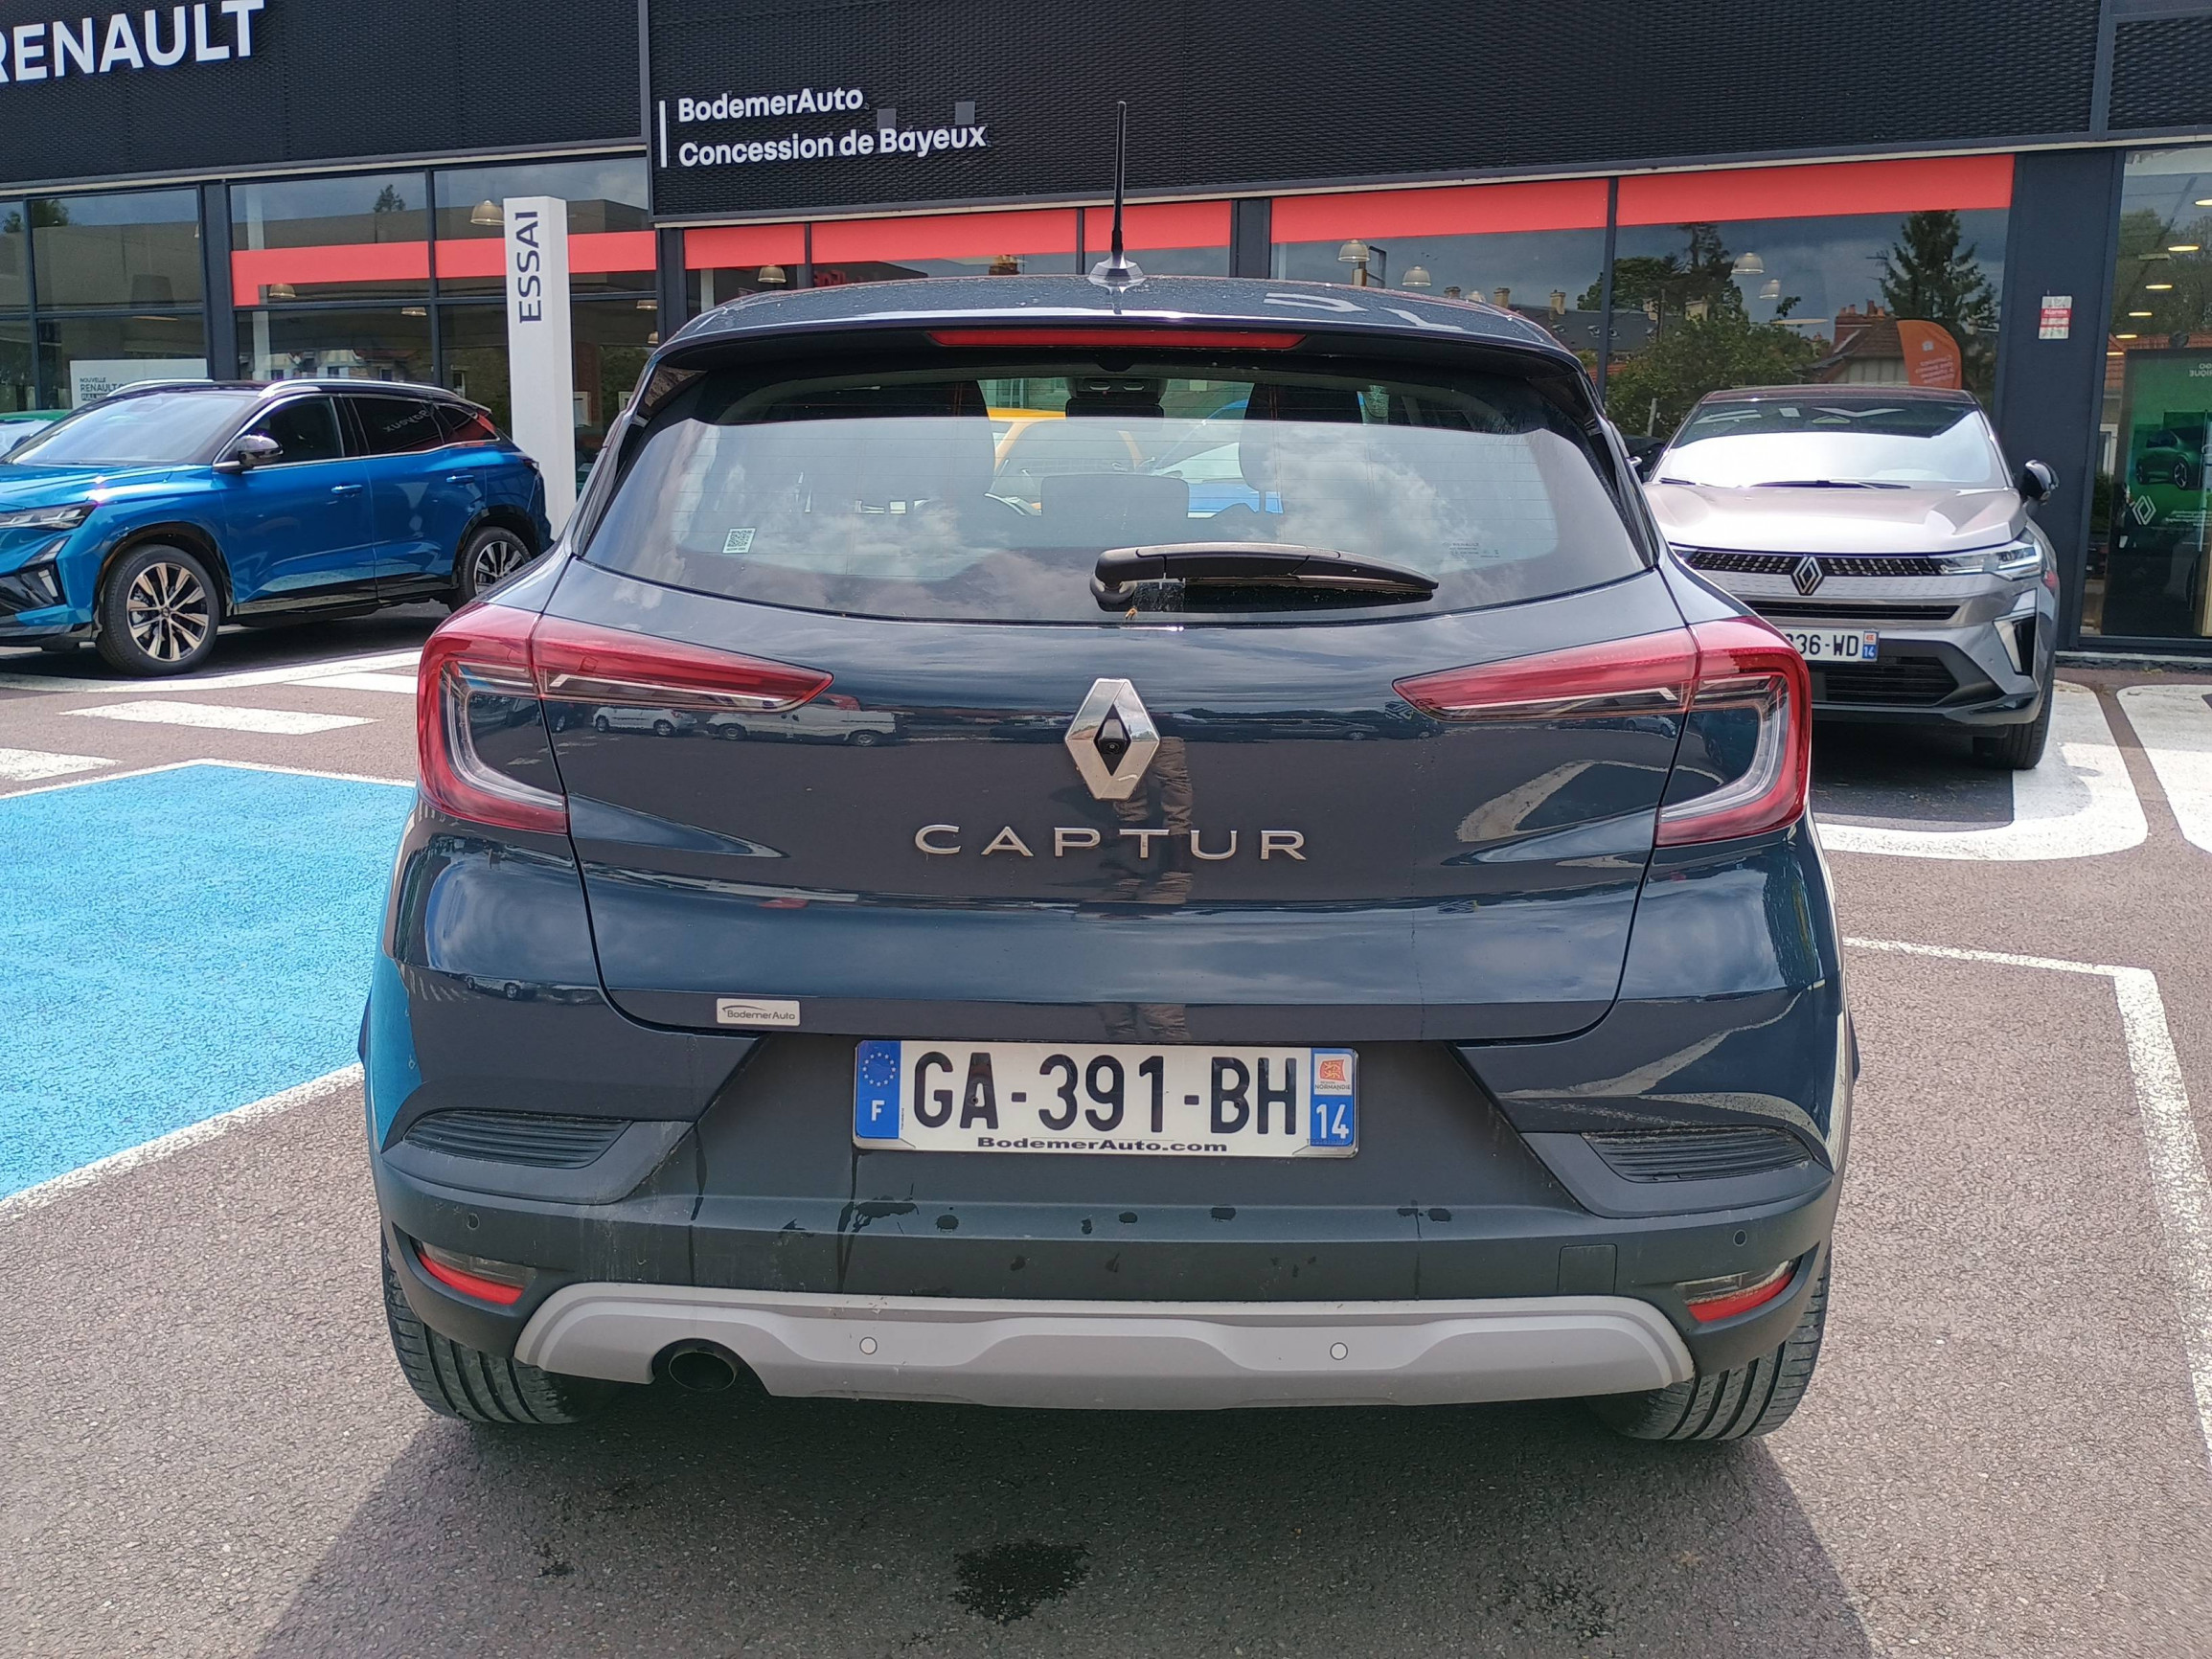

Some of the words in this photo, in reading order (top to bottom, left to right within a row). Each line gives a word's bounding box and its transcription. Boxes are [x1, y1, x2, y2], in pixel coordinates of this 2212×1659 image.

[0, 0, 265, 83] ENAULT
[677, 86, 864, 123] BodemerAuto
[678, 133, 835, 168] Concession
[839, 129, 875, 156] de
[878, 125, 989, 158] Bayeux
[514, 211, 542, 324] ESSAI
[80, 383, 117, 392] RENAULT
[915, 824, 1307, 861] CAPTUR
[727, 1010, 796, 1020] BodemerAuto
[871, 1100, 885, 1122] F
[913, 1051, 1297, 1136] GA-391-BH
[1316, 1103, 1349, 1139] 14
[977, 1137, 1228, 1152] BodemerAuto.com
